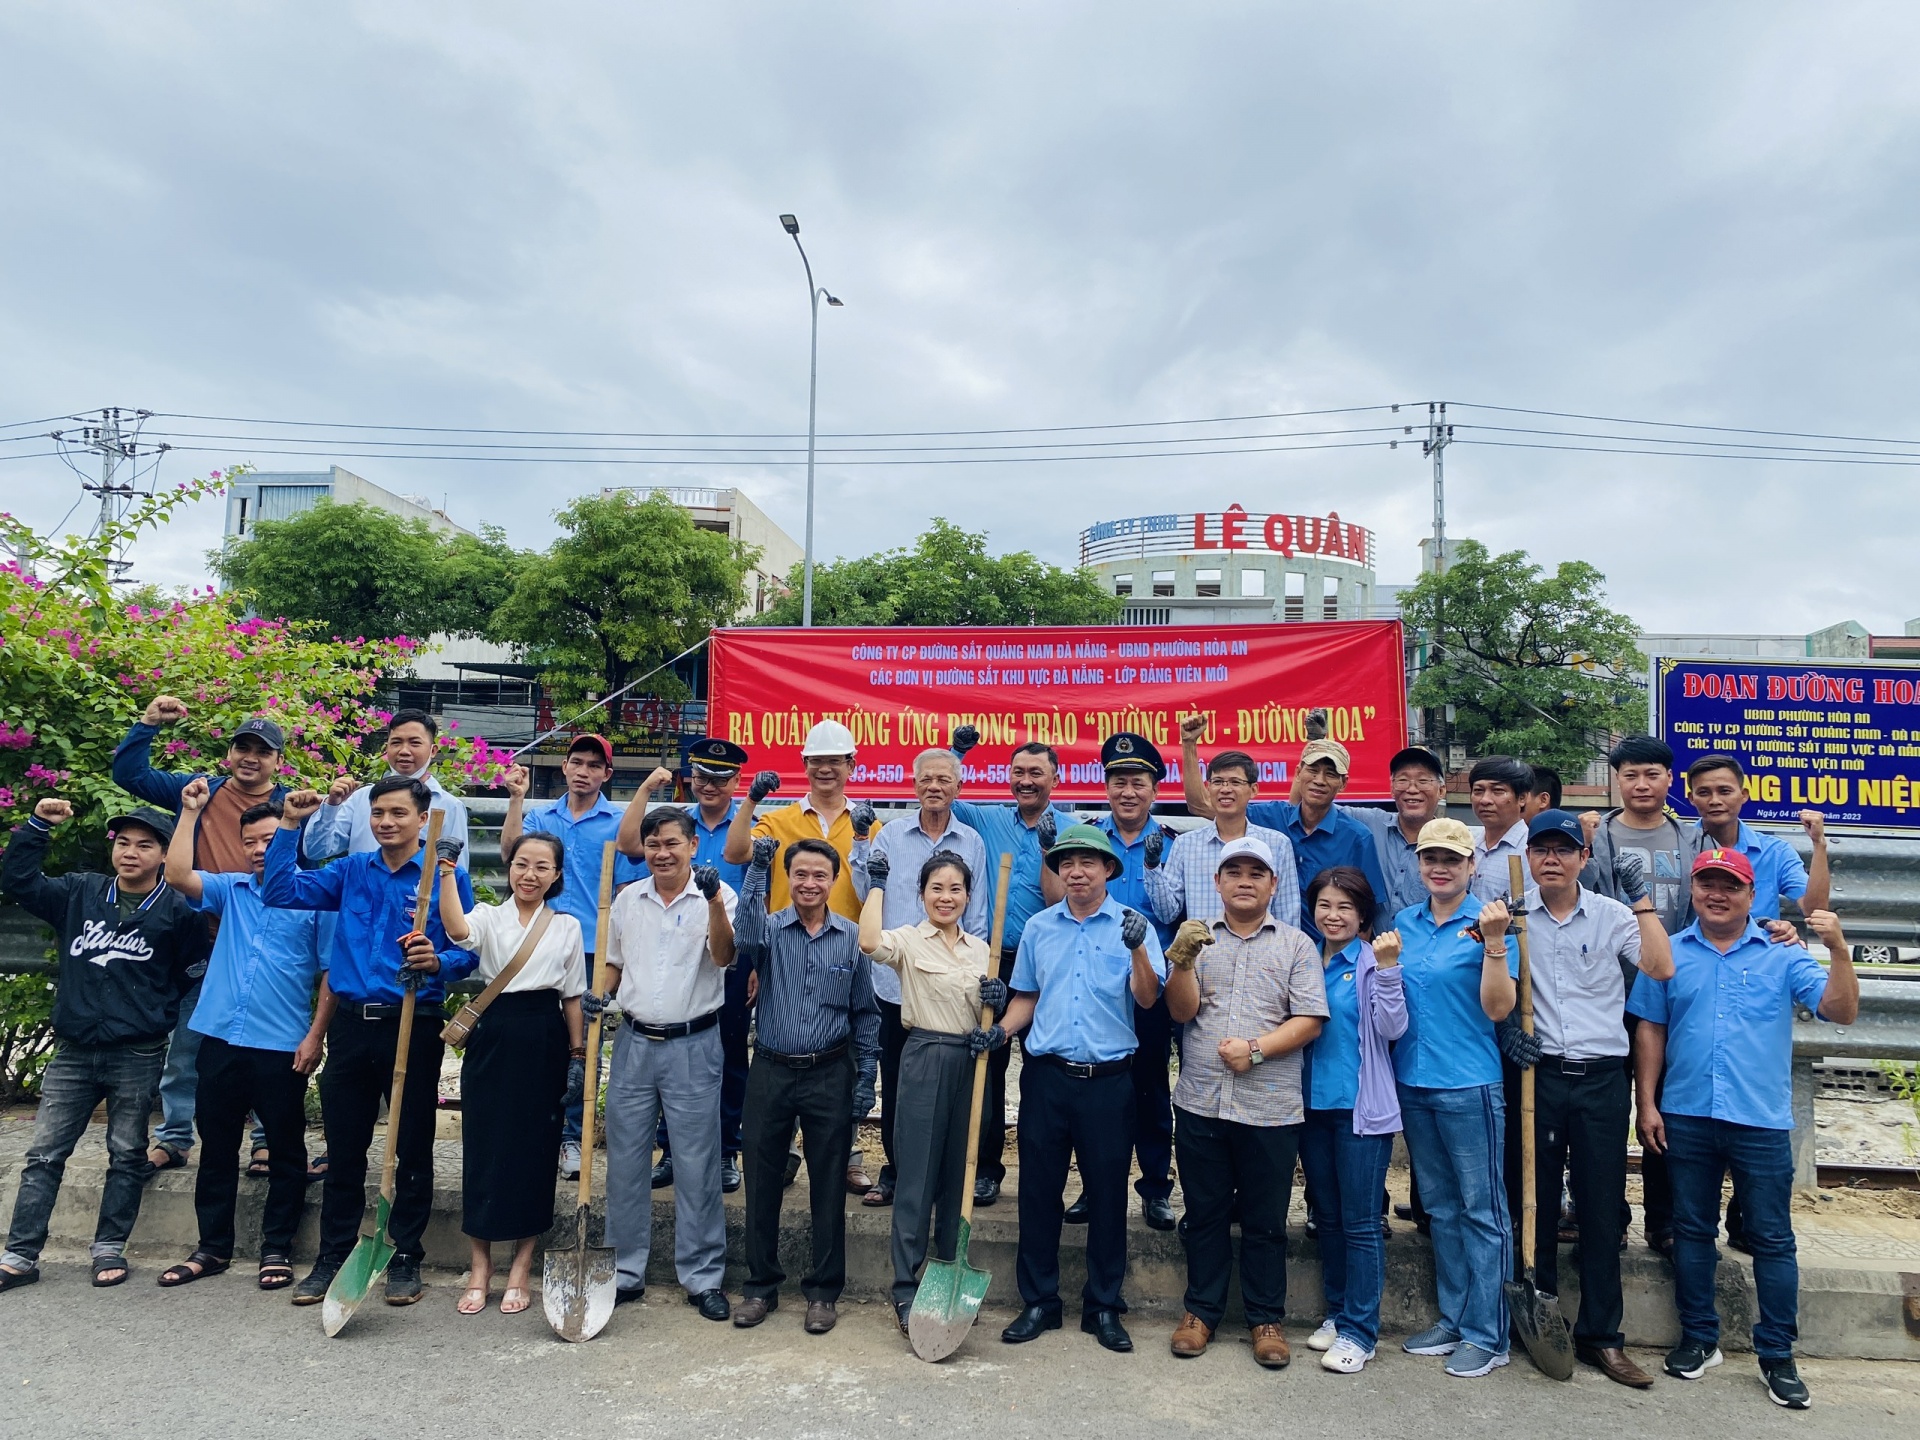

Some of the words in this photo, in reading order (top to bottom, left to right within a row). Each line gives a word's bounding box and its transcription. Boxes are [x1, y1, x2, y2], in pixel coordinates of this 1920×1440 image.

[1120, 518, 1135, 536] TY
[1140, 514, 1177, 533] TNHH
[1194, 503, 1248, 549] LÊ
[1264, 511, 1366, 563] QUÂN
[852, 643, 882, 660] CÔNG
[886, 646, 899, 660] TY
[902, 645, 916, 660] CP
[920, 642, 958, 660] ĐƯỜNG
[961, 640, 982, 660] SẮT
[986, 640, 1023, 661] QUẢNG
[1027, 644, 1053, 659] NAM
[1057, 641, 1072, 659] ĐÀ
[1075, 639, 1107, 659] NẴNG
[1118, 643, 1150, 658] UBND
[1153, 638, 1200, 657] PHƯỜNG
[1204, 638, 1228, 656] HÒA
[1231, 641, 1248, 656] AN
[870, 668, 892, 685] CÁC
[896, 669, 918, 685] ĐƠN
[922, 670, 933, 688] VỊ
[936, 666, 974, 685] ĐƯỜNG
[978, 664, 999, 685] SẮT
[1002, 670, 1024, 685] KHU
[1028, 668, 1050, 687] VỰC
[1053, 666, 1069, 684] ĐÀ
[1072, 664, 1104, 684] NẴNG
[1115, 665, 1136, 684] LỚP
[1140, 663, 1172, 683] ĐẢNG
[1175, 664, 1202, 683] VIÊN
[1206, 665, 1228, 682] MỚI
[1683, 673, 1758, 703] ĐOẠN
[1767, 672, 1864, 703] ĐƯỜNG
[729, 712, 755, 746] RA
[822, 703, 891, 746] ỞNG
[898, 705, 940, 746] ỨNG
[1023, 705, 1077, 746] TRÀO
[1744, 709, 1775, 721] UBND
[1778, 709, 1825, 722] PHƯỜNG
[1854, 713, 1870, 724] AN
[1674, 721, 1704, 733] CÔNG
[1708, 723, 1721, 734] TY
[1725, 724, 1740, 735] CP
[1744, 724, 1782, 736] ĐƯỜNG
[1854, 729, 1881, 740] NAM
[1891, 729, 1908, 741] ĐÀ
[1687, 737, 1710, 749] CÁC
[1713, 739, 1736, 750] ĐƠN
[1740, 740, 1752, 752] VỊ
[1756, 739, 1795, 752] ĐƯỜNG
[1824, 743, 1847, 754] KHU
[1851, 744, 1875, 756] VỰC
[1878, 744, 1895, 756] ĐÀ
[1751, 755, 1773, 766] LỚP
[1777, 756, 1808, 768] ĐẢNG
[1841, 759, 1864, 771] MỚI
[1791, 775, 1848, 805] LƯU
[1757, 809, 1778, 818] Ngày
